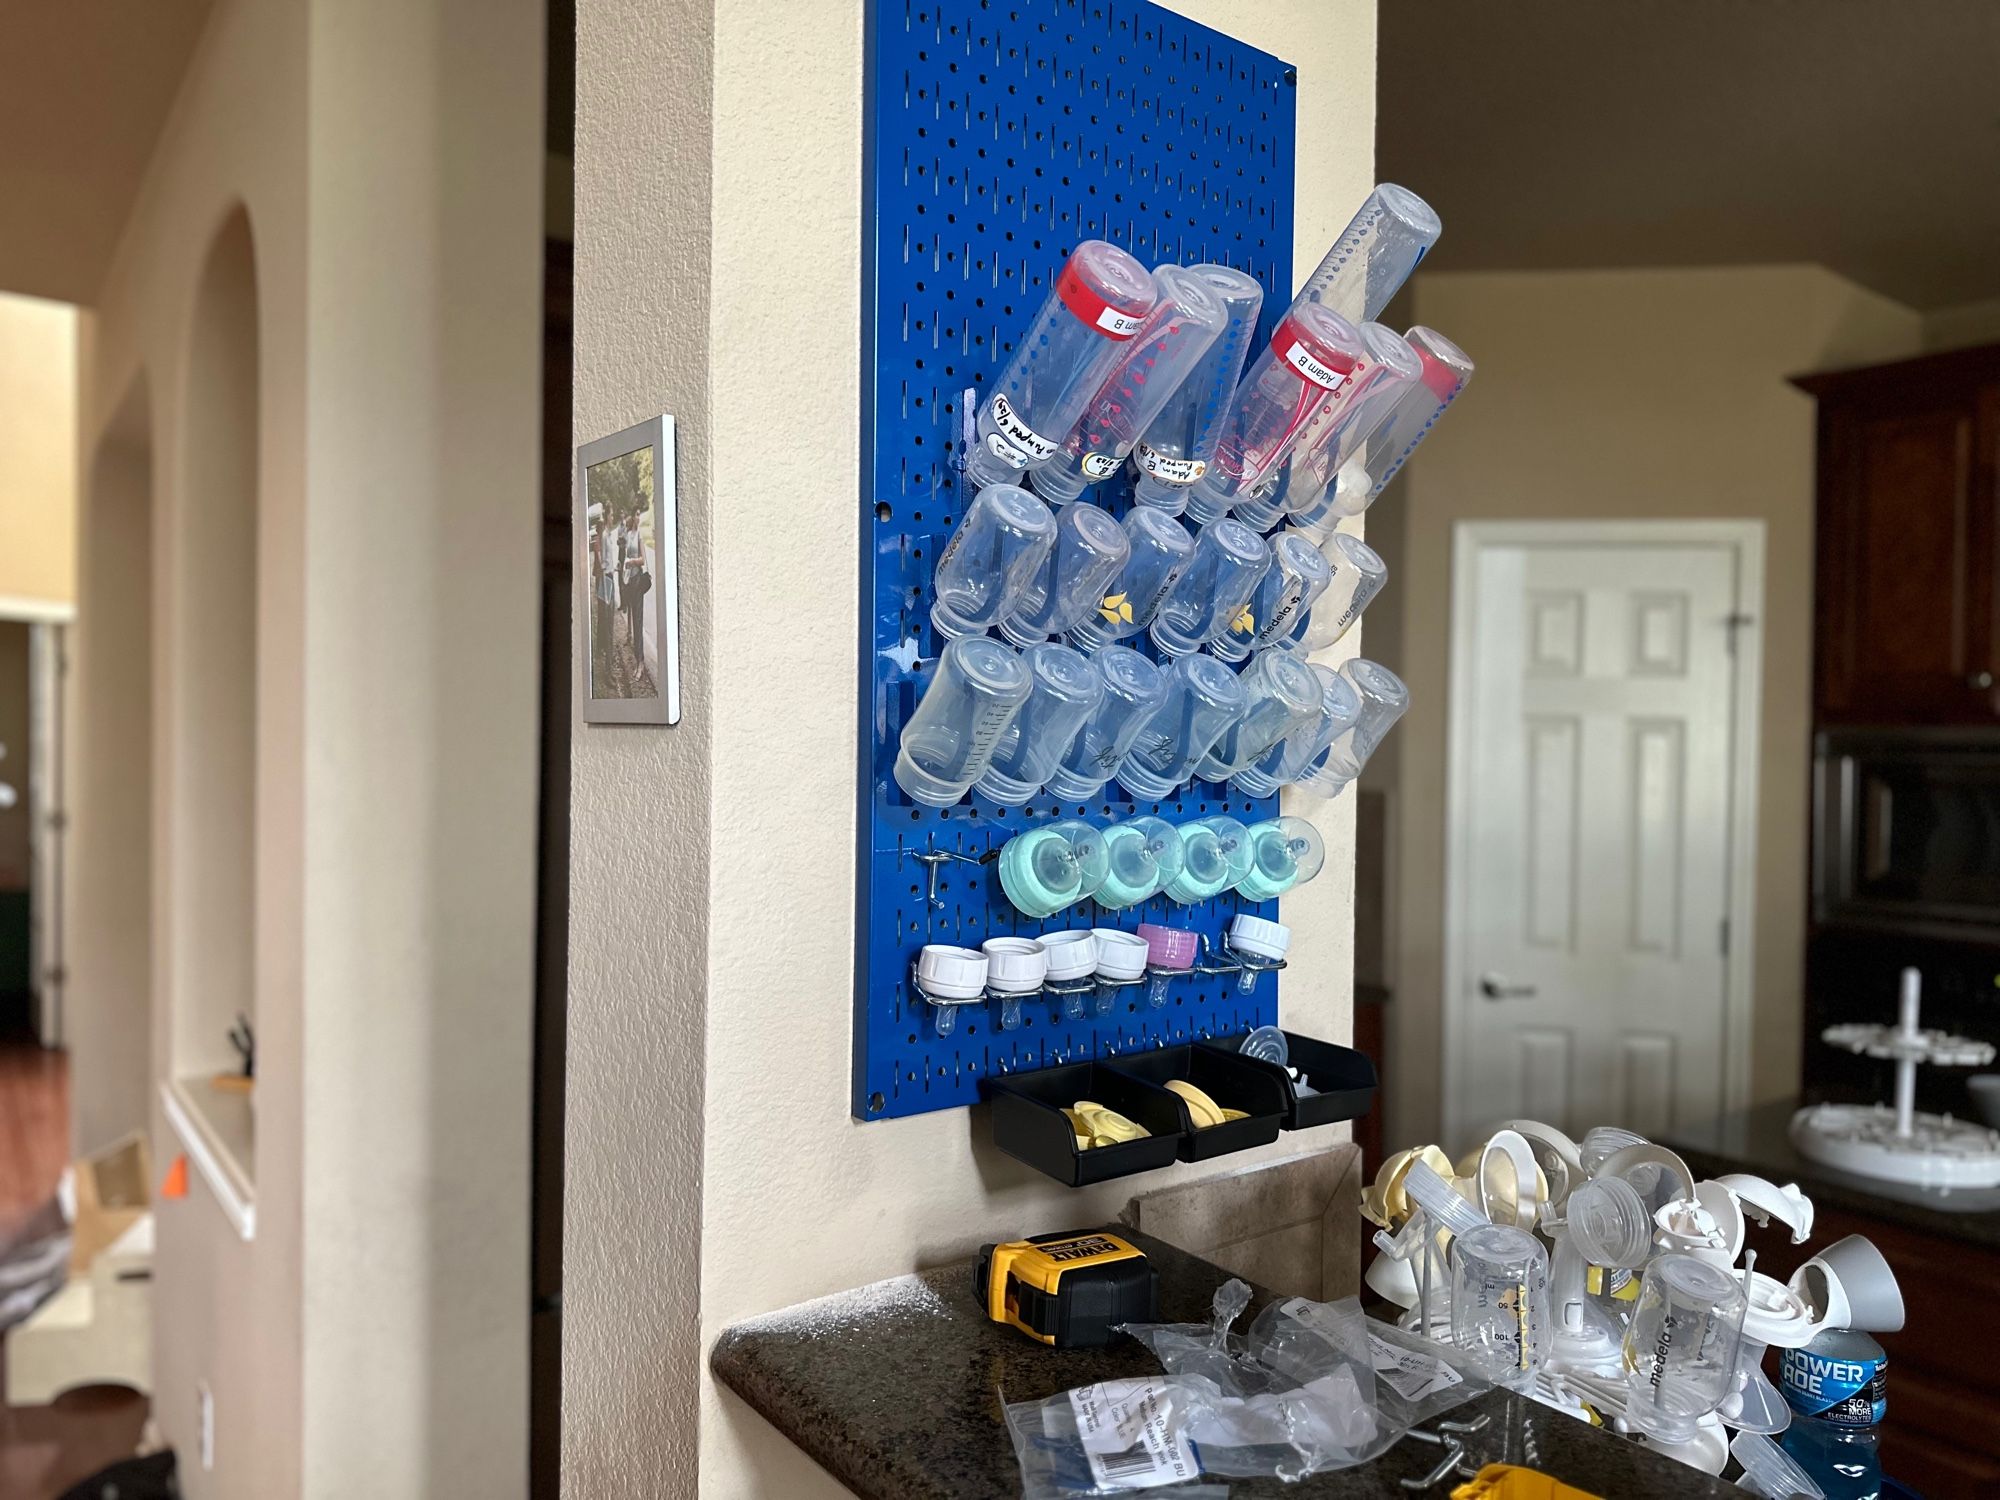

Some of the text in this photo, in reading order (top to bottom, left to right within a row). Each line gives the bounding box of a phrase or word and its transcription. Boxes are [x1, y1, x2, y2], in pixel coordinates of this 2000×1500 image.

[1113, 319, 1125, 330] B
[1298, 355, 1336, 384] Adam B
[1008, 424, 1045, 455] Pumped
[1147, 460, 1191, 480] Adam B
[938, 530, 964, 576] medela
[1259, 606, 1292, 640] medela
[1051, 1242, 1118, 1261] DEWALT
[1494, 1333, 1509, 1341] 100
[1650, 1332, 1672, 1388] medela
[1785, 1347, 1864, 1382] POWER
[1784, 1363, 1823, 1395] ADE
[1827, 1412, 1872, 1421] ELECTROLYTES
[1848, 1398, 1870, 1409] 50%
[1848, 1407, 1872, 1416] MORE
[1145, 1422, 1160, 1450] Reach
[1154, 1414, 1180, 1461] 10-HM-002
[1174, 1462, 1186, 1477] BU
